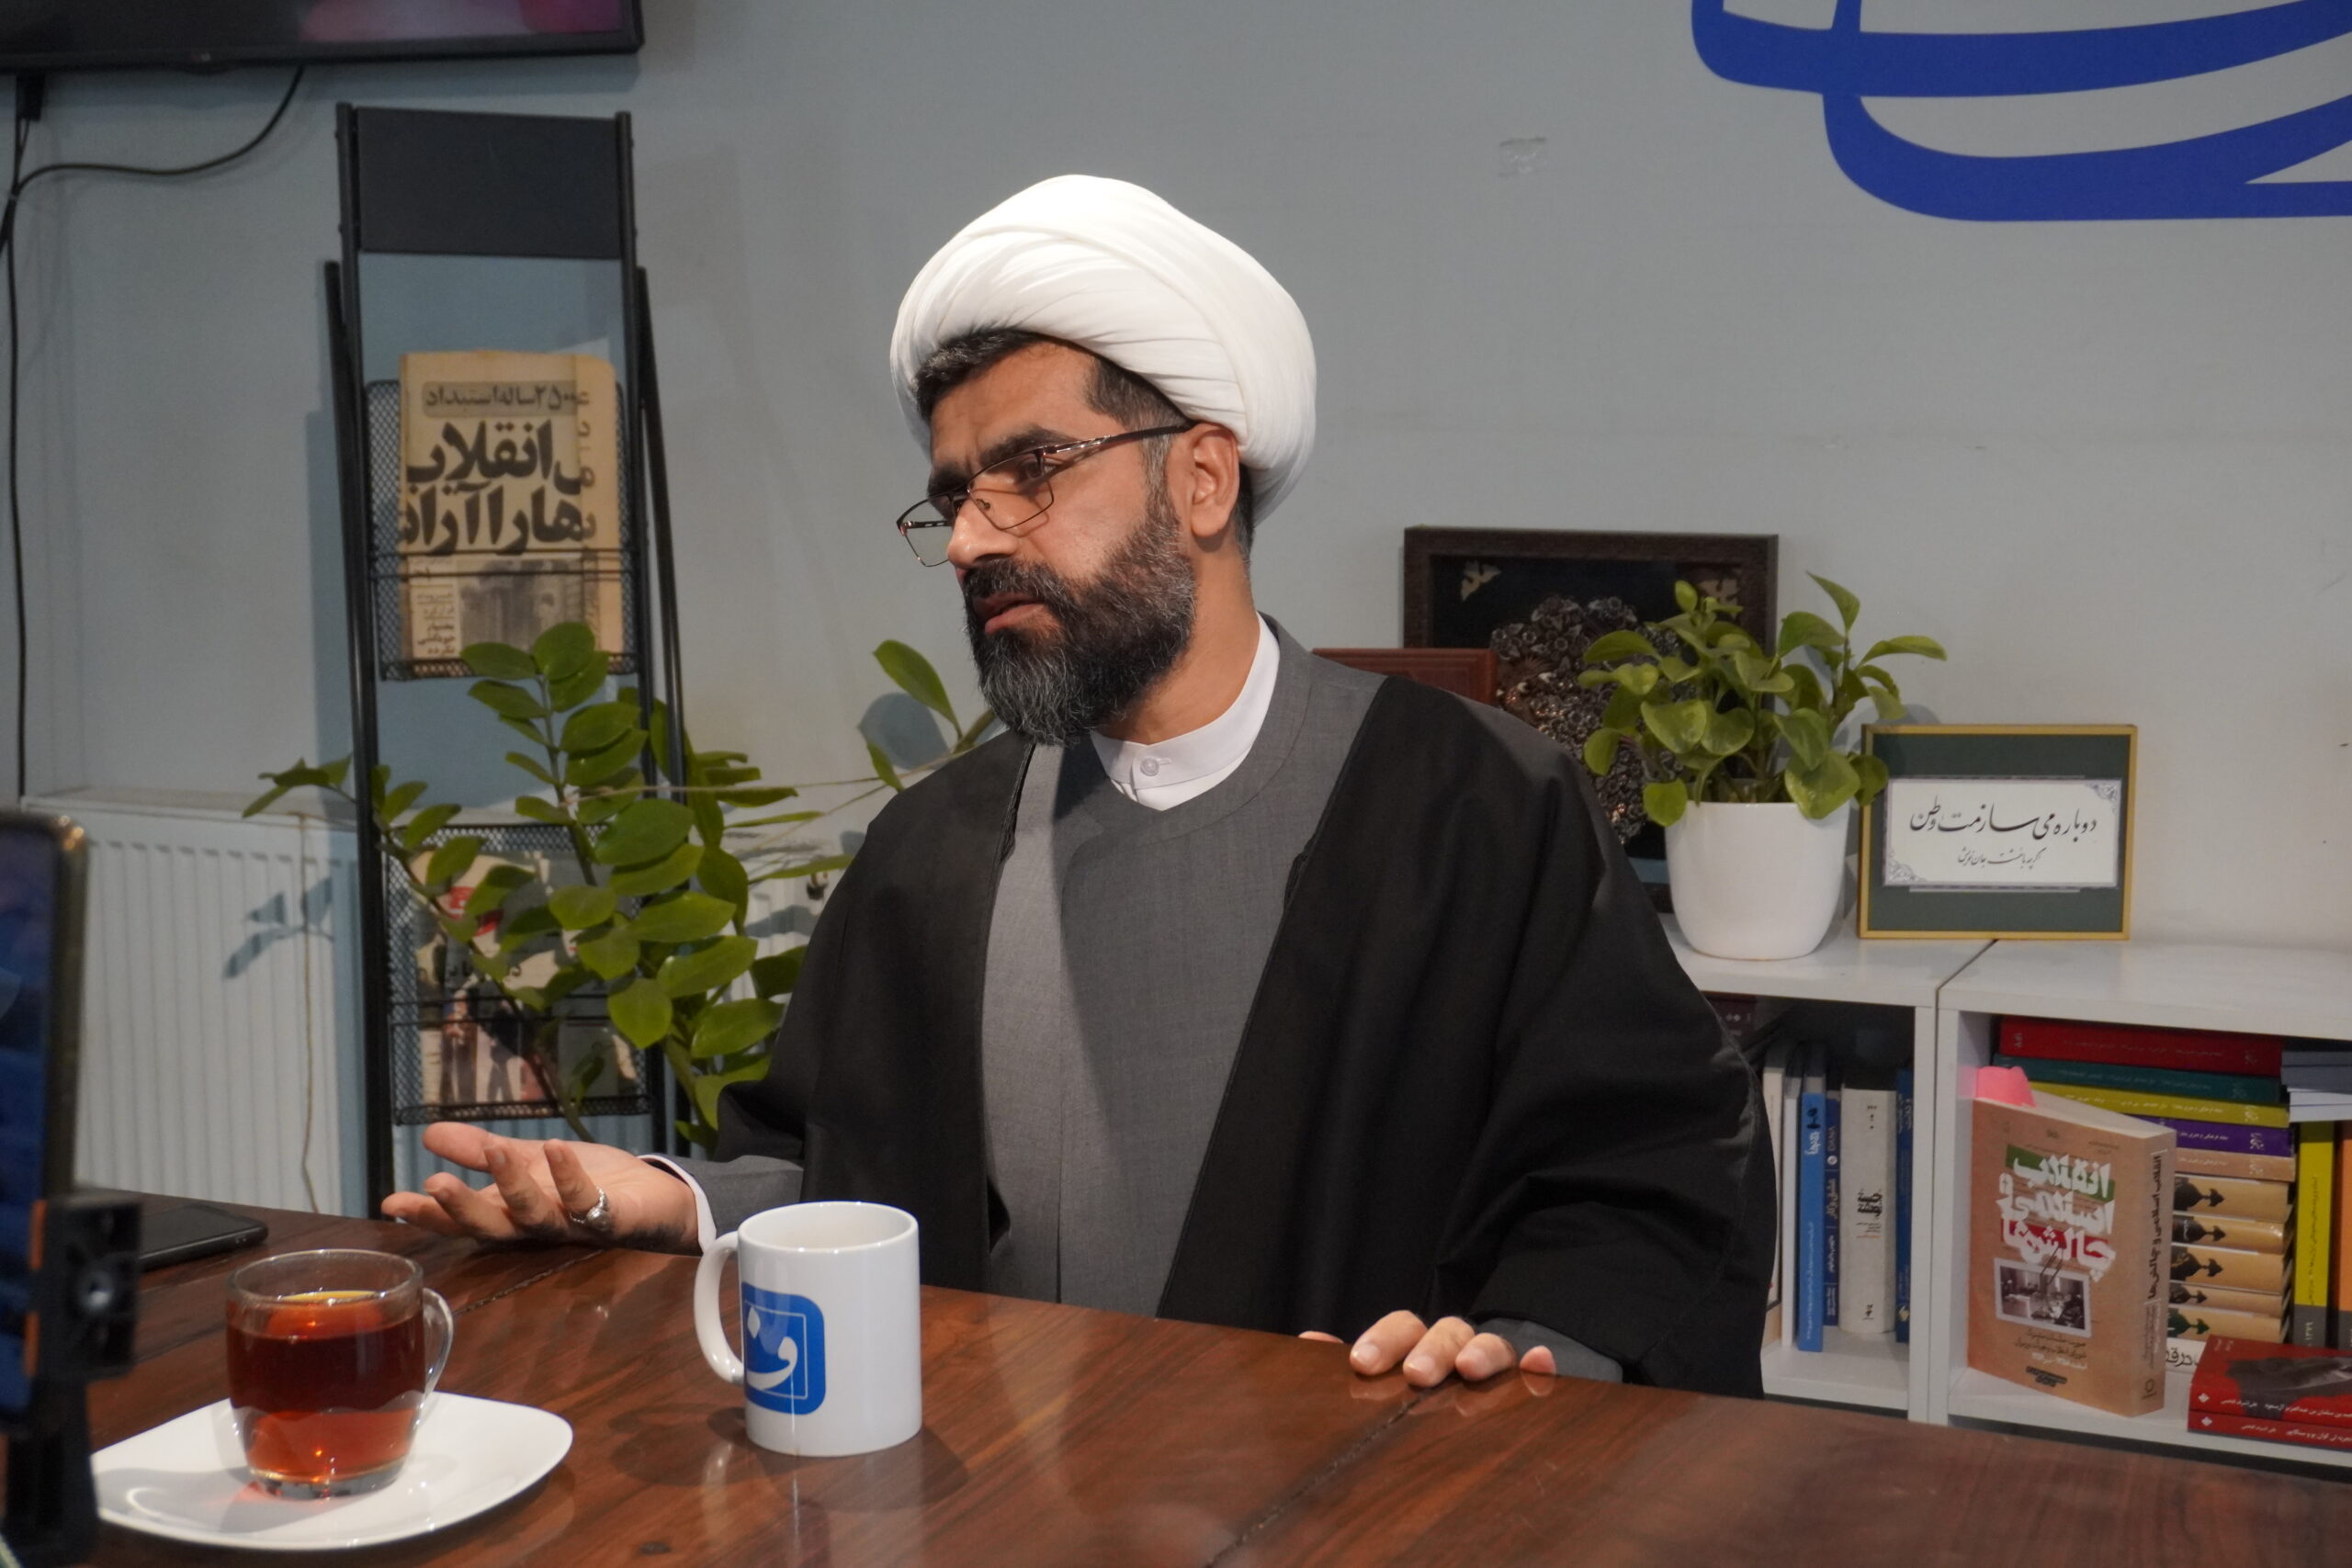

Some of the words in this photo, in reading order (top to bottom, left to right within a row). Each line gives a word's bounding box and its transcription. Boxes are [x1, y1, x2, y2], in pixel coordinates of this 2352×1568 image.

[406, 418, 553, 494] انقلاب
[1910, 794, 1941, 831] وطن
[2052, 808, 2098, 842] دوباره
[2012, 1153, 2111, 1198] انقلاب
[2002, 1190, 2115, 1235] اسلامی
